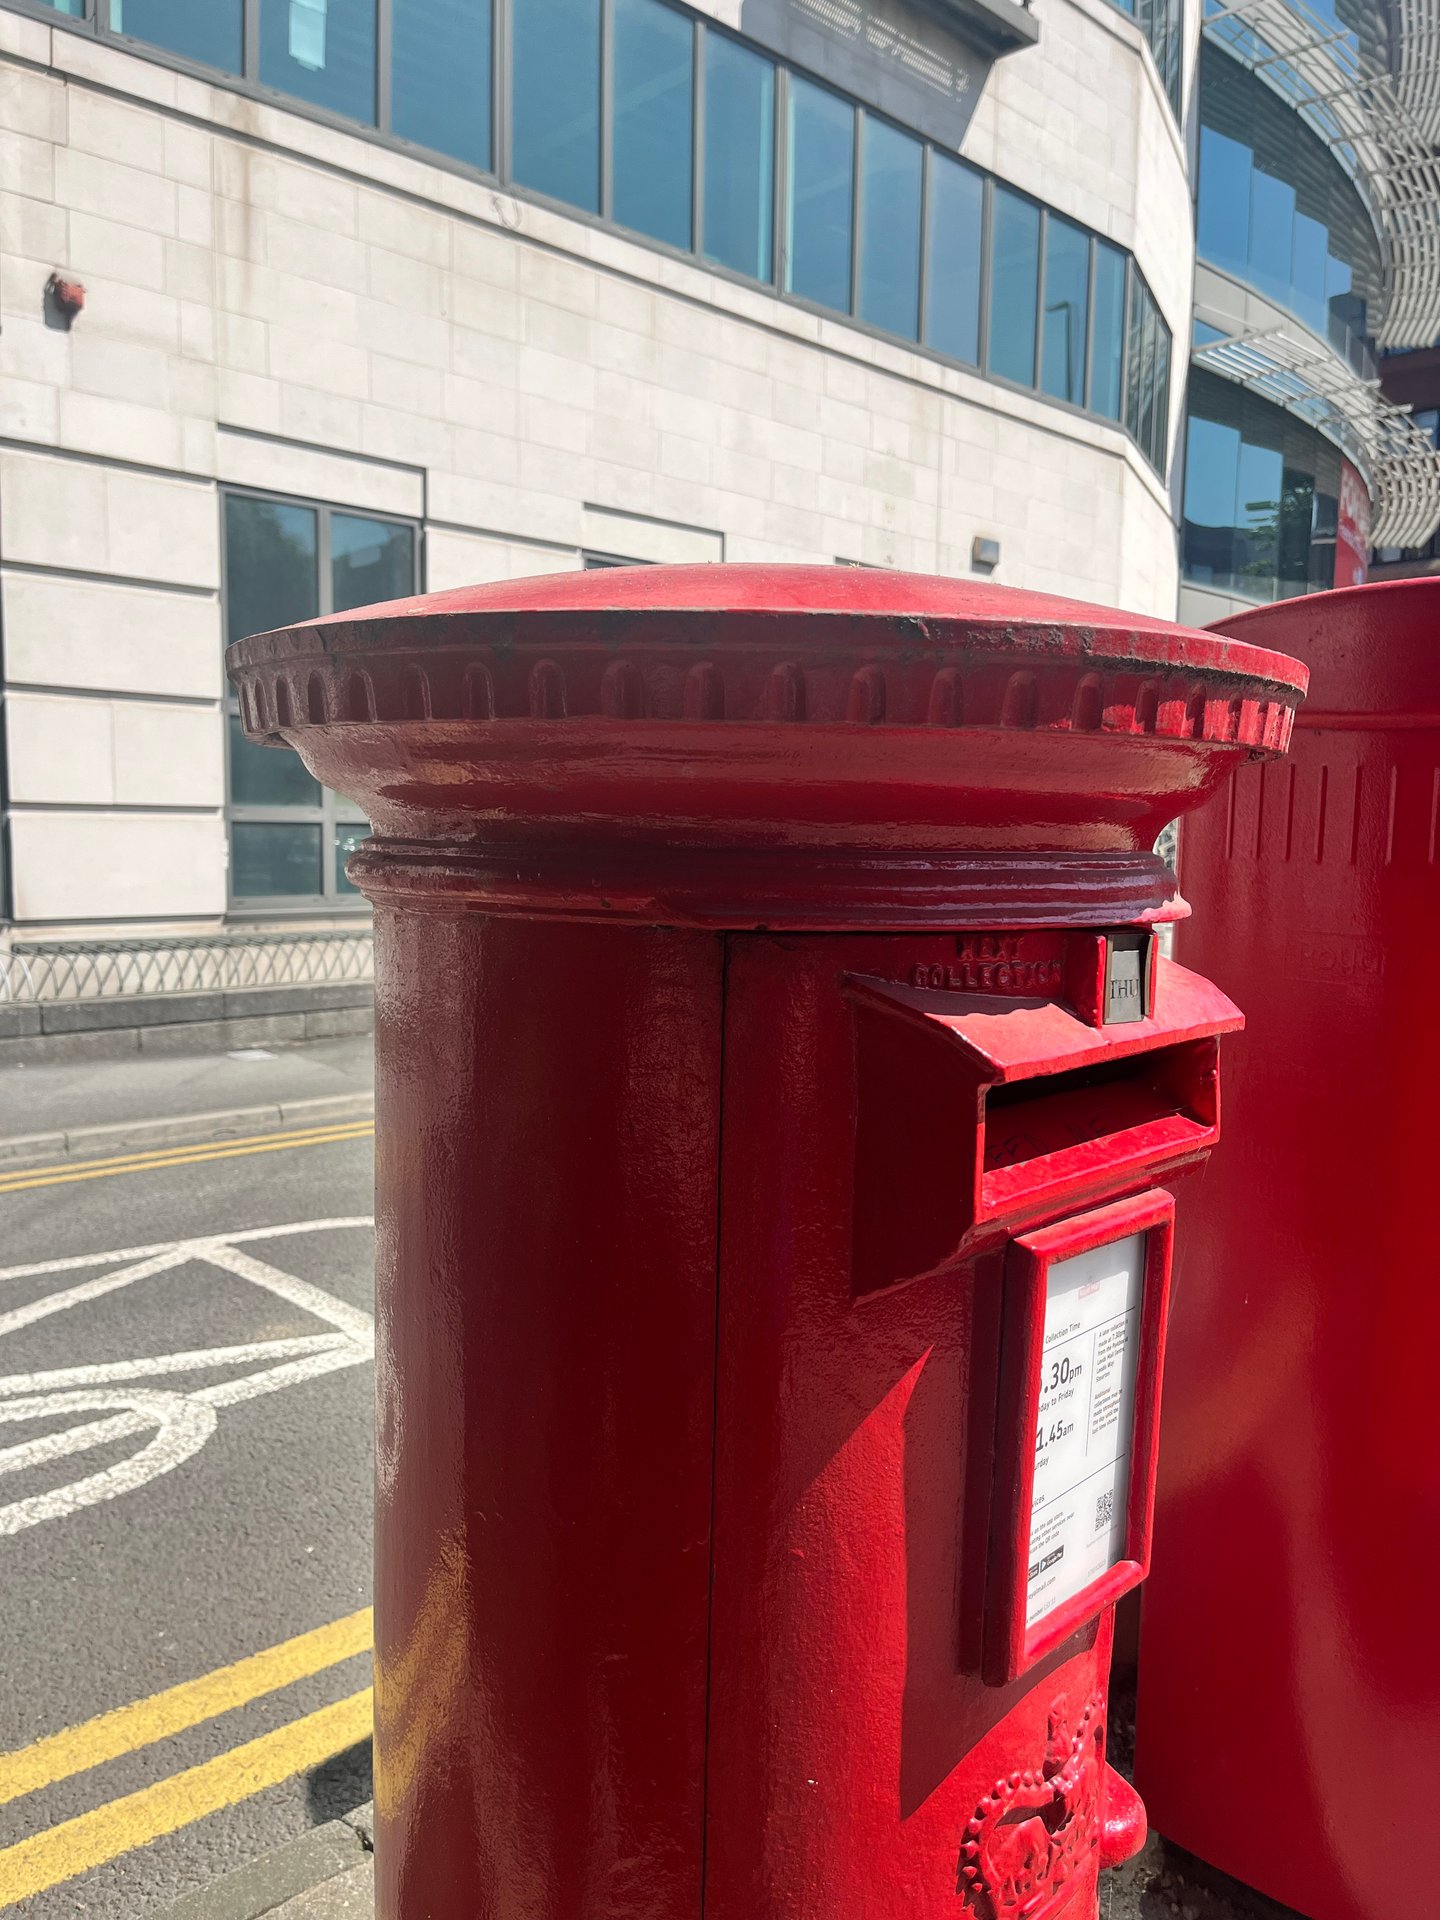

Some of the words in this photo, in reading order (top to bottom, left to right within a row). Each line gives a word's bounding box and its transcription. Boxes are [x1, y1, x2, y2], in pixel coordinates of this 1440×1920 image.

[912, 959, 1064, 990] COLLECTION
[1109, 977, 1140, 1000] THU
[1045, 1328, 1069, 1344] Collection
[1069, 1322, 1081, 1332] Time
[1040, 1357, 1082, 1394] .30pm
[1051, 1397, 1057, 1406] to
[1058, 1387, 1075, 1402] Friday
